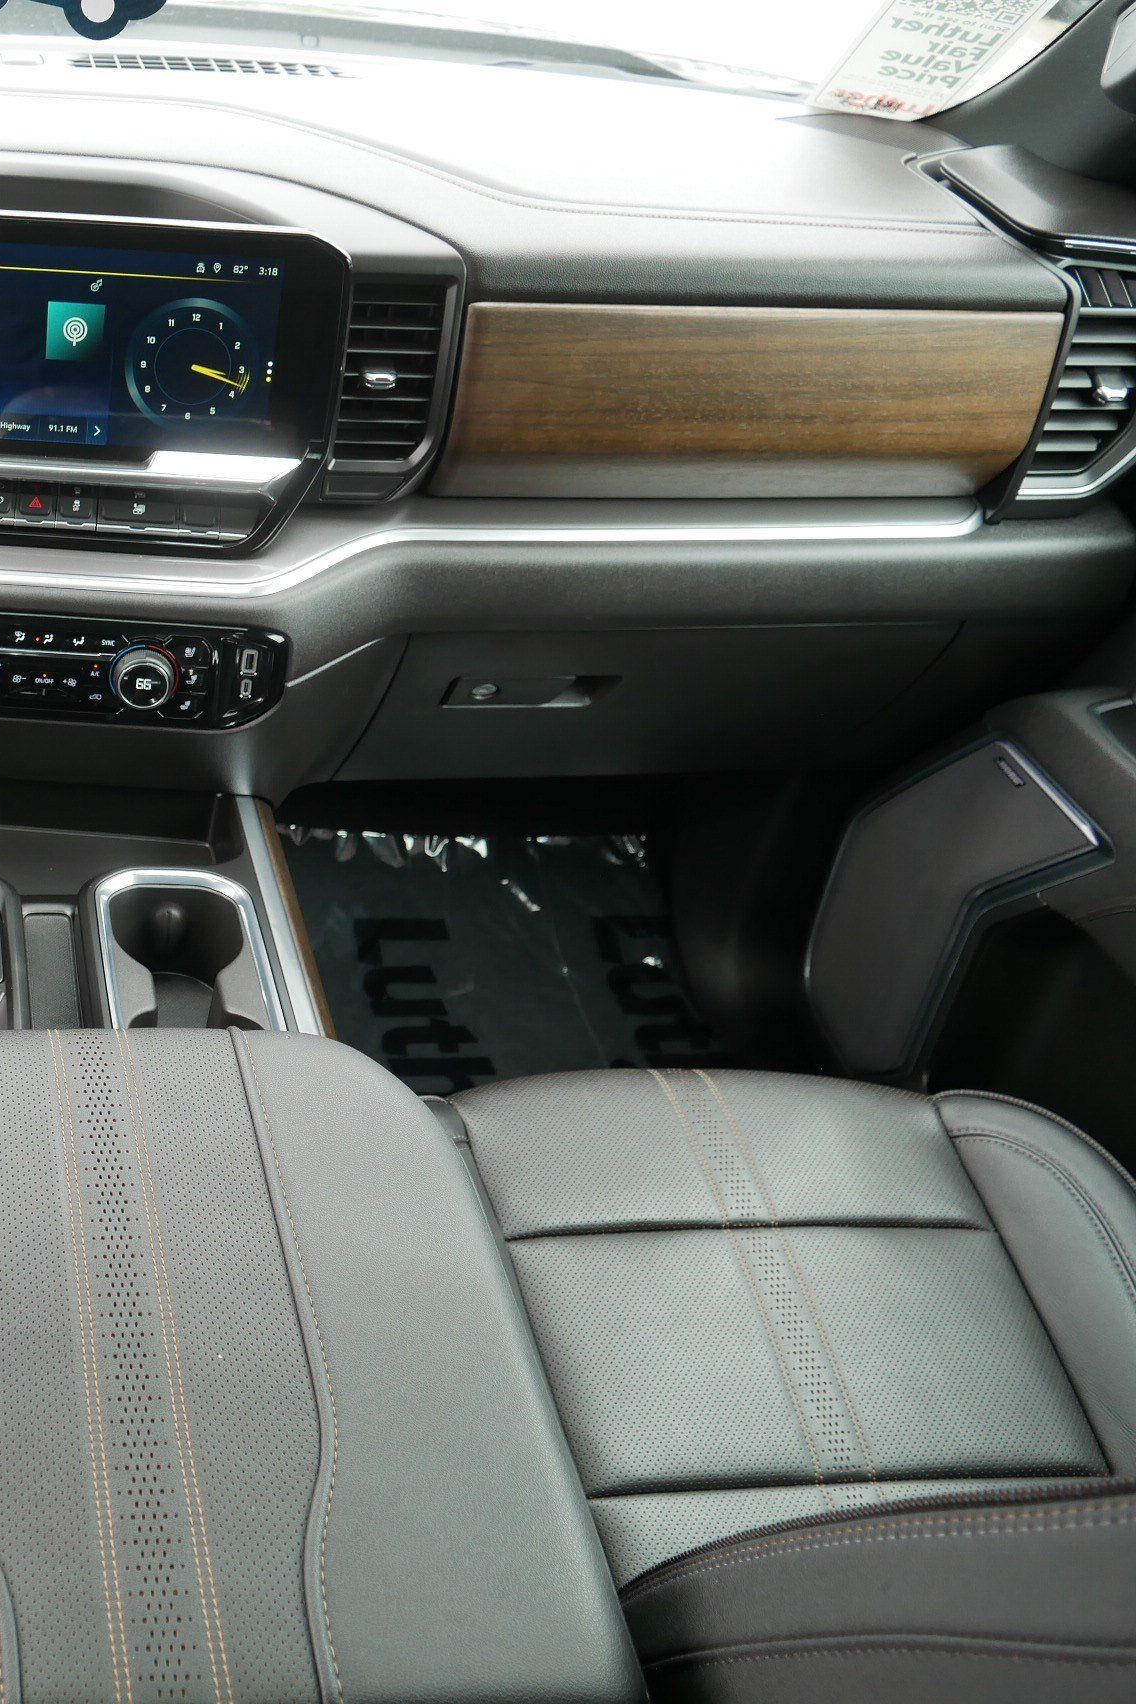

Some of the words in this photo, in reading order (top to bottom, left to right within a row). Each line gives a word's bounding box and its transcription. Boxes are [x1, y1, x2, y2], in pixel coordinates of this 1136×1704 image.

[258, 266, 279, 277] 3:18
[191, 313, 202, 322] 12
[167, 318, 175, 327] 11
[146, 336, 156, 345] 10
[234, 341, 241, 350] 2
[140, 360, 147, 369] 9
[238, 366, 245, 374] 3
[144, 385, 151, 393] 8
[228, 390, 235, 398] 4
[160, 404, 167, 412] 7
[210, 406, 216, 415] 5
[184, 412, 191, 420] 6
[0, 421, 31, 432] Highway
[48, 424, 65, 433] 91.1
[65, 425, 78, 434] FM
[101, 639, 116, 647] SYNC
[135, 678, 152, 691] 66
